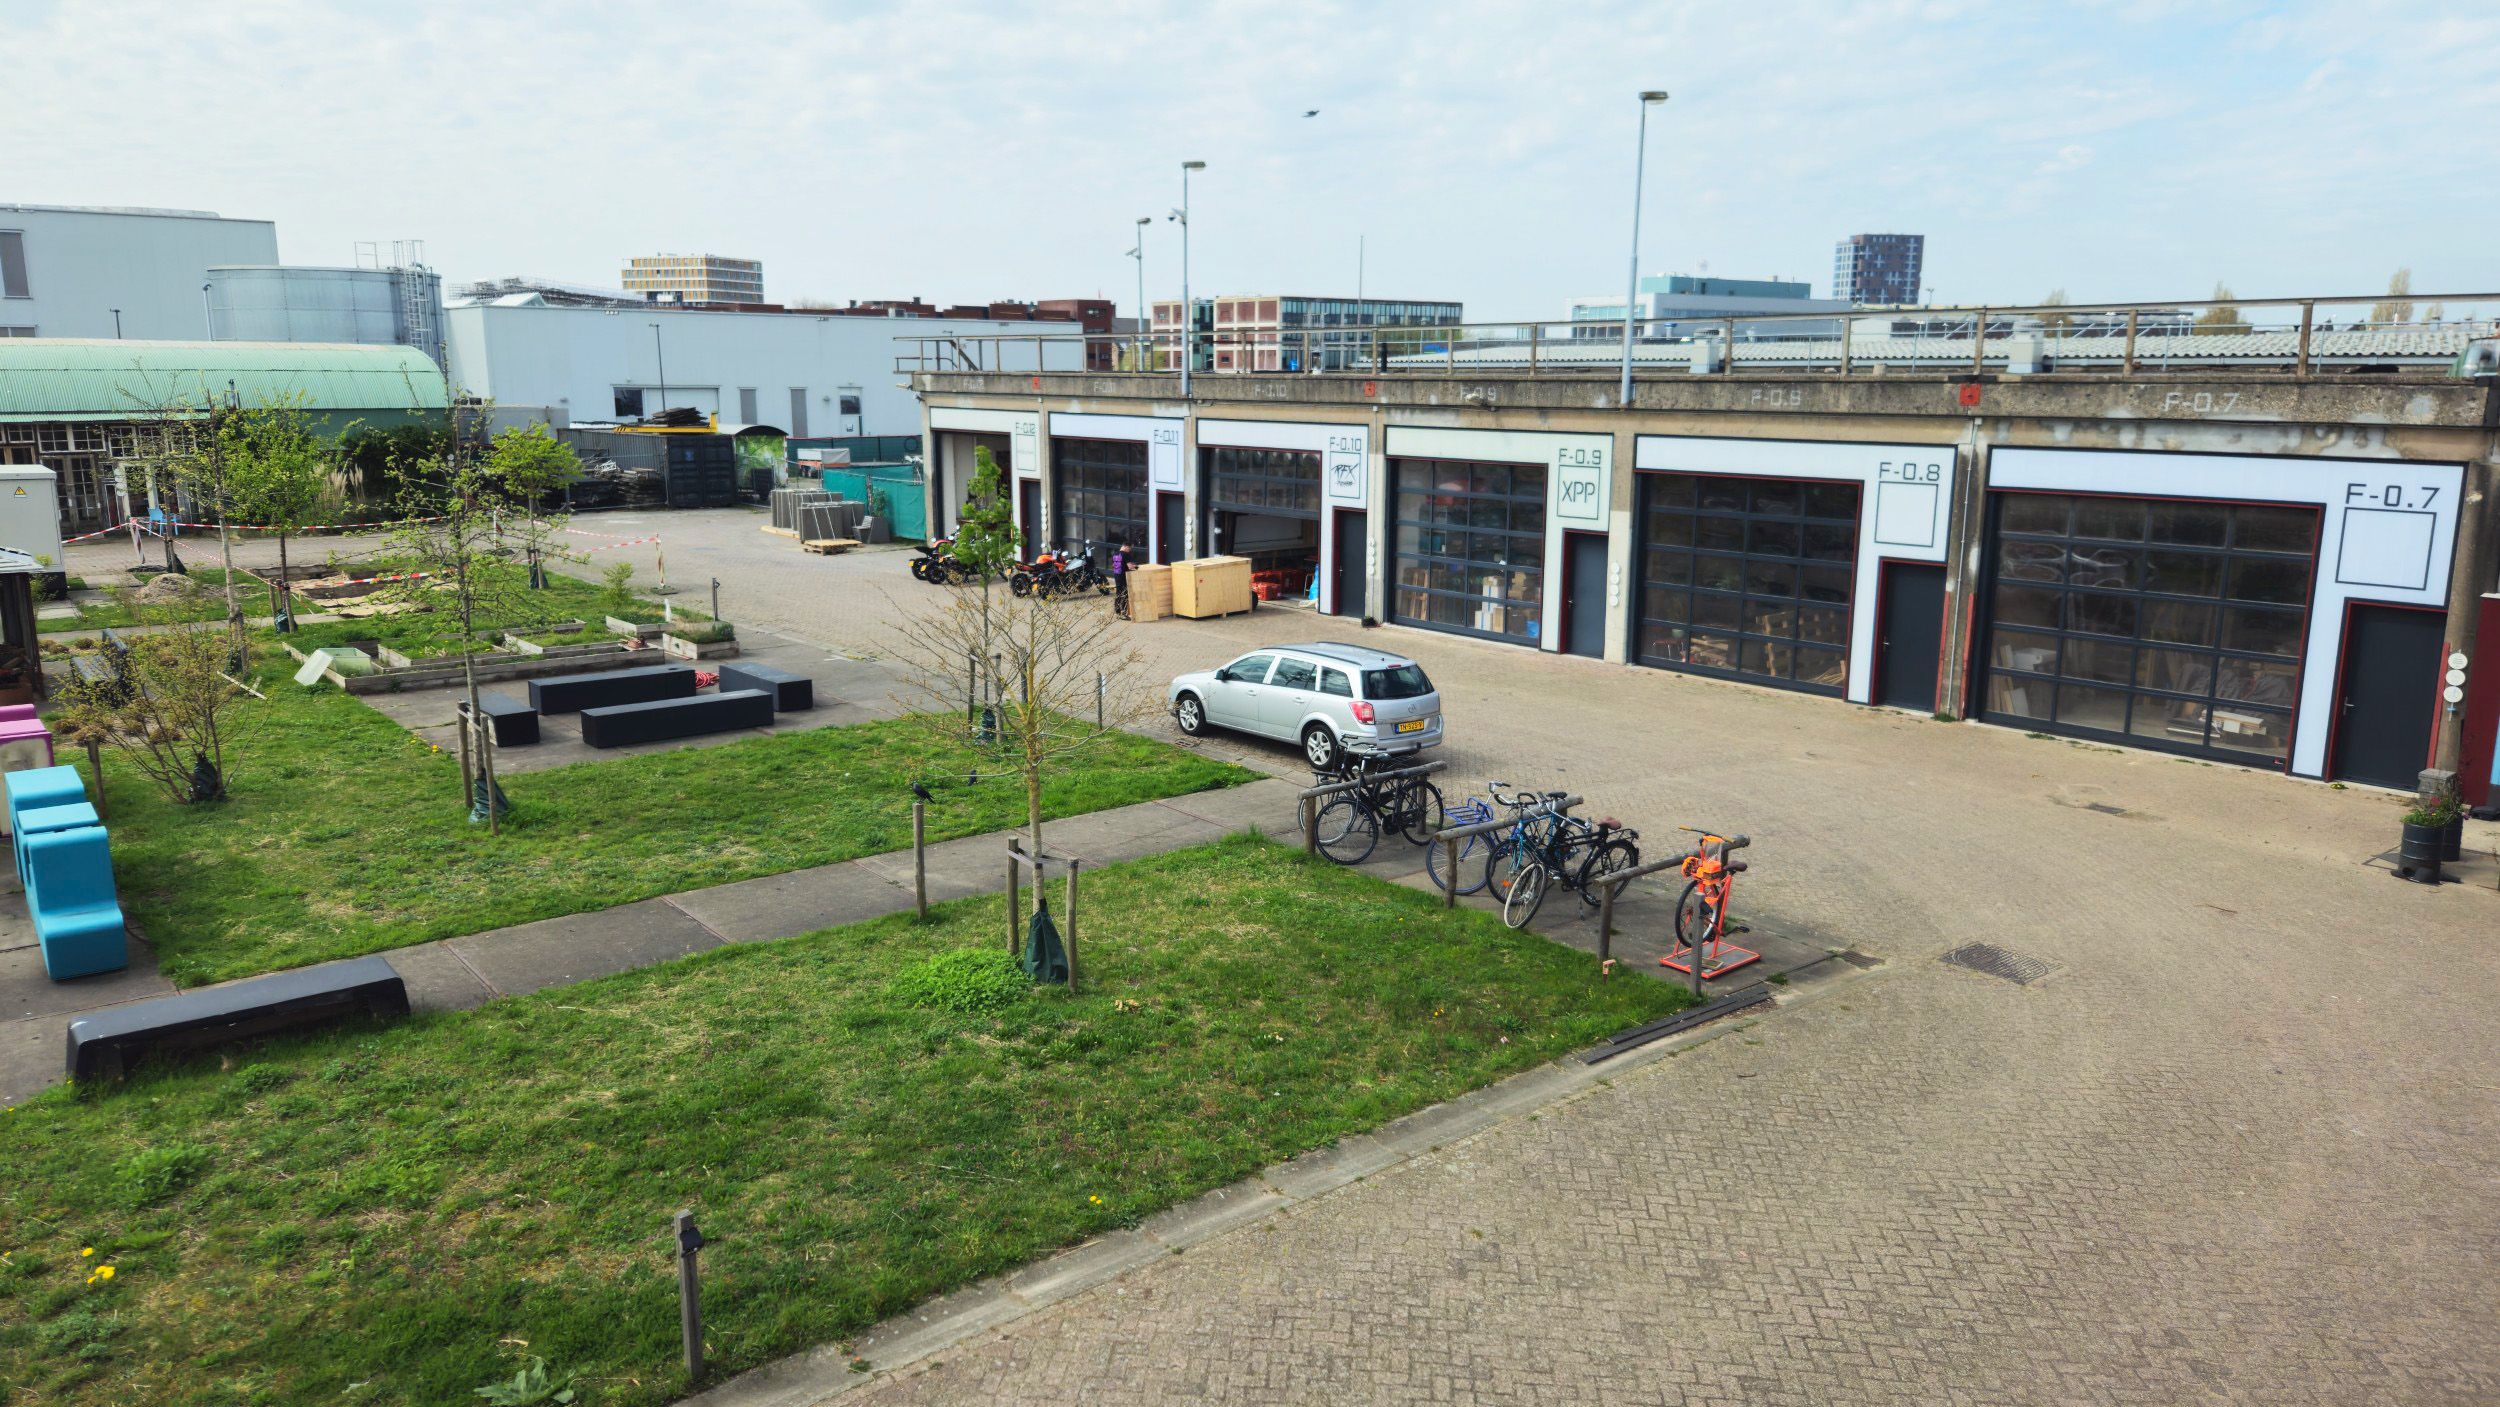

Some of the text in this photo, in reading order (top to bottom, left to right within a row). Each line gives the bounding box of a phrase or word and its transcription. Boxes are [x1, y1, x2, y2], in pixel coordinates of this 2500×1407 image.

[1254, 384, 1287, 398] F-0.10
[1751, 389, 1801, 406] F-0.8
[2162, 392, 2240, 413] F-0.7
[1015, 422, 1036, 435] F-0.12
[1153, 429, 1179, 443] F-0.11
[1329, 436, 1362, 451] F-0.10
[1558, 448, 1602, 465] F-0.9
[1879, 461, 1941, 482] F-0.8
[1562, 480, 1596, 504] XPP
[2345, 483, 2440, 509] F-0.7
